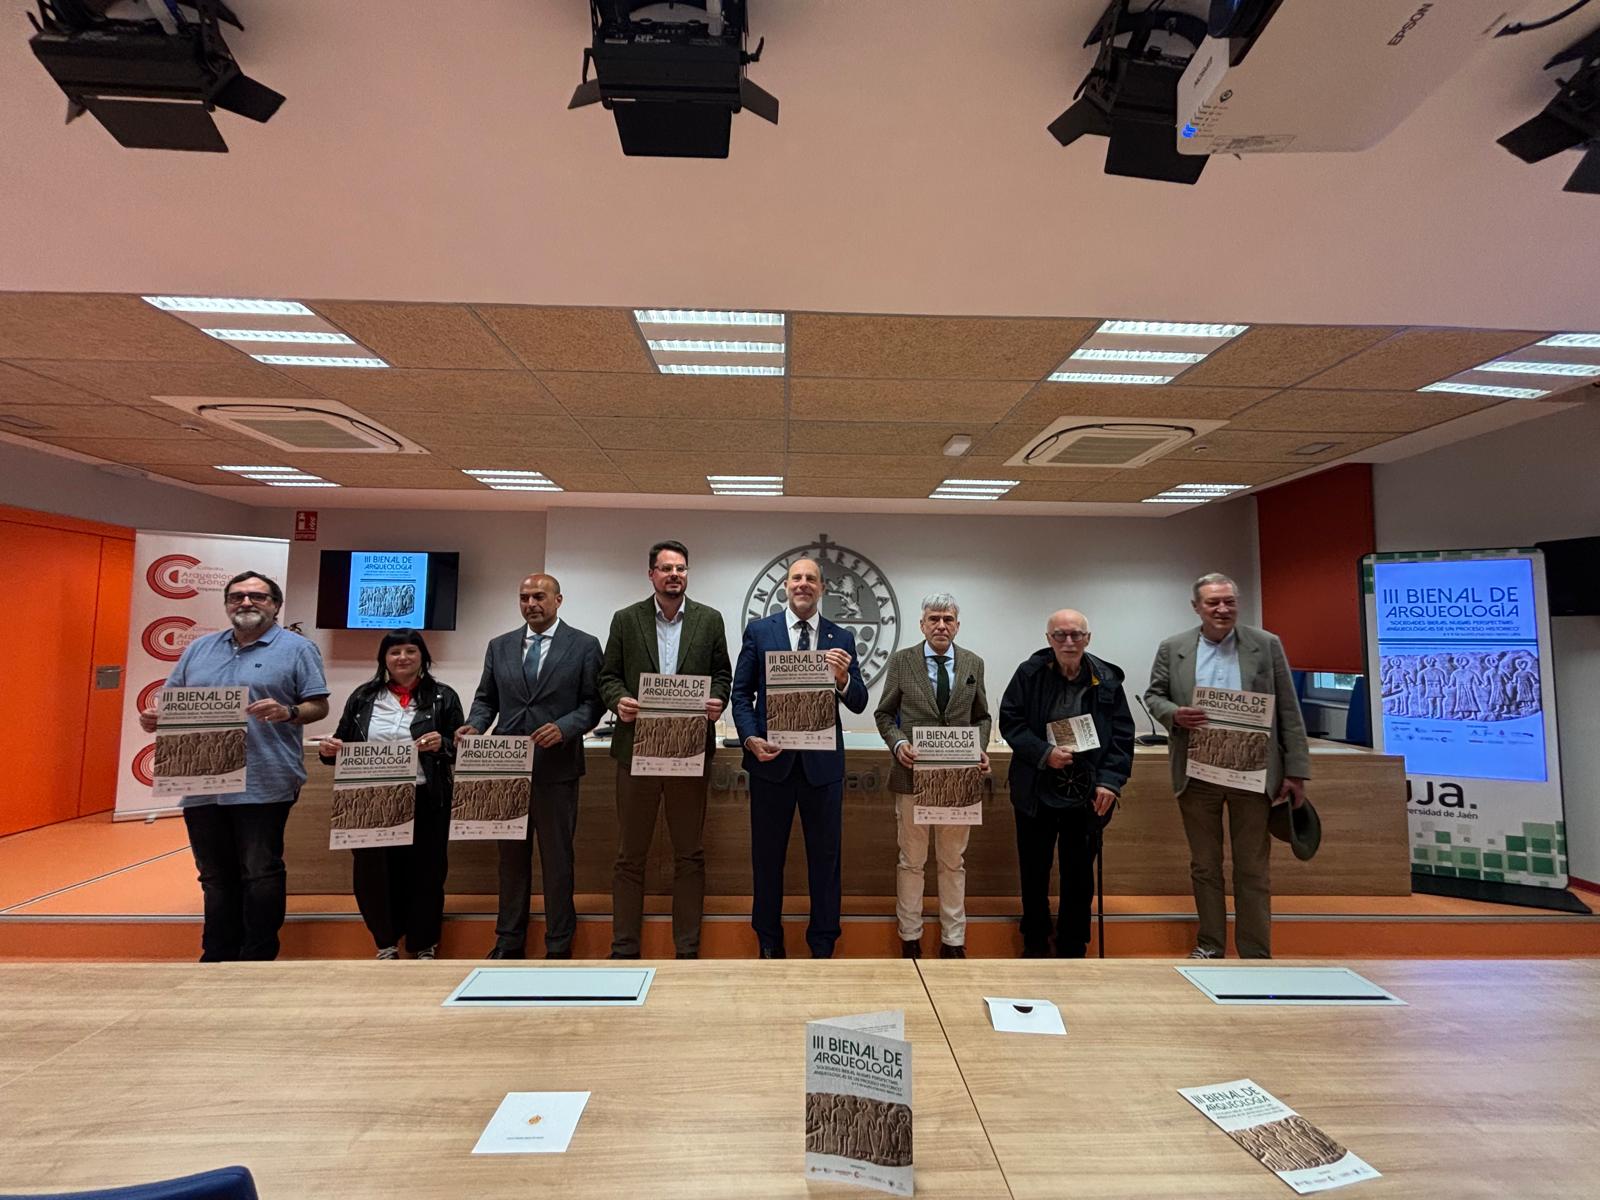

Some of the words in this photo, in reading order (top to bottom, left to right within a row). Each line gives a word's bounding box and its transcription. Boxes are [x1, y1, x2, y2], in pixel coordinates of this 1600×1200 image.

[1387, 3, 1434, 45] EPSON
[373, 555, 400, 564] BIENAL
[402, 556, 413, 564] DE
[1383, 589, 1399, 604] III
[1406, 587, 1482, 604] BIENAL
[1490, 586, 1519, 603] DE
[1385, 602, 1520, 618] ARQUEOLOGÍA
[768, 655, 777, 664] III
[780, 654, 813, 664] BIENAL
[643, 677, 652, 687] III
[654, 678, 689, 689] BIENAL
[692, 680, 705, 689] DE
[163, 691, 173, 702] III
[177, 691, 222, 702] BIENAL
[225, 690, 241, 701] DE
[1196, 690, 1206, 699] III
[1208, 691, 1249, 704] BIENAL
[1251, 696, 1268, 707] DE
[916, 730, 924, 740] III
[926, 730, 959, 740] BIENAL
[962, 731, 974, 740] DE
[461, 739, 470, 749] III
[473, 740, 511, 749] BIENAL
[514, 740, 528, 749] DE
[340, 746, 350, 757] III
[354, 745, 393, 757] BIENAL
[397, 745, 412, 755] DE
[1407, 808, 1441, 817] ersidad
[1443, 810, 1454, 818] de
[1456, 811, 1478, 820] Jaén
[812, 1035, 824, 1049] III
[828, 1037, 879, 1061] BIENAL
[883, 1048, 903, 1067] DE
[813, 1051, 903, 1080] ARQUEOLOGÍA
[1190, 1095, 1206, 1105] III
[1202, 1089, 1245, 1103] BIENAL
[1240, 1086, 1261, 1096] DE
